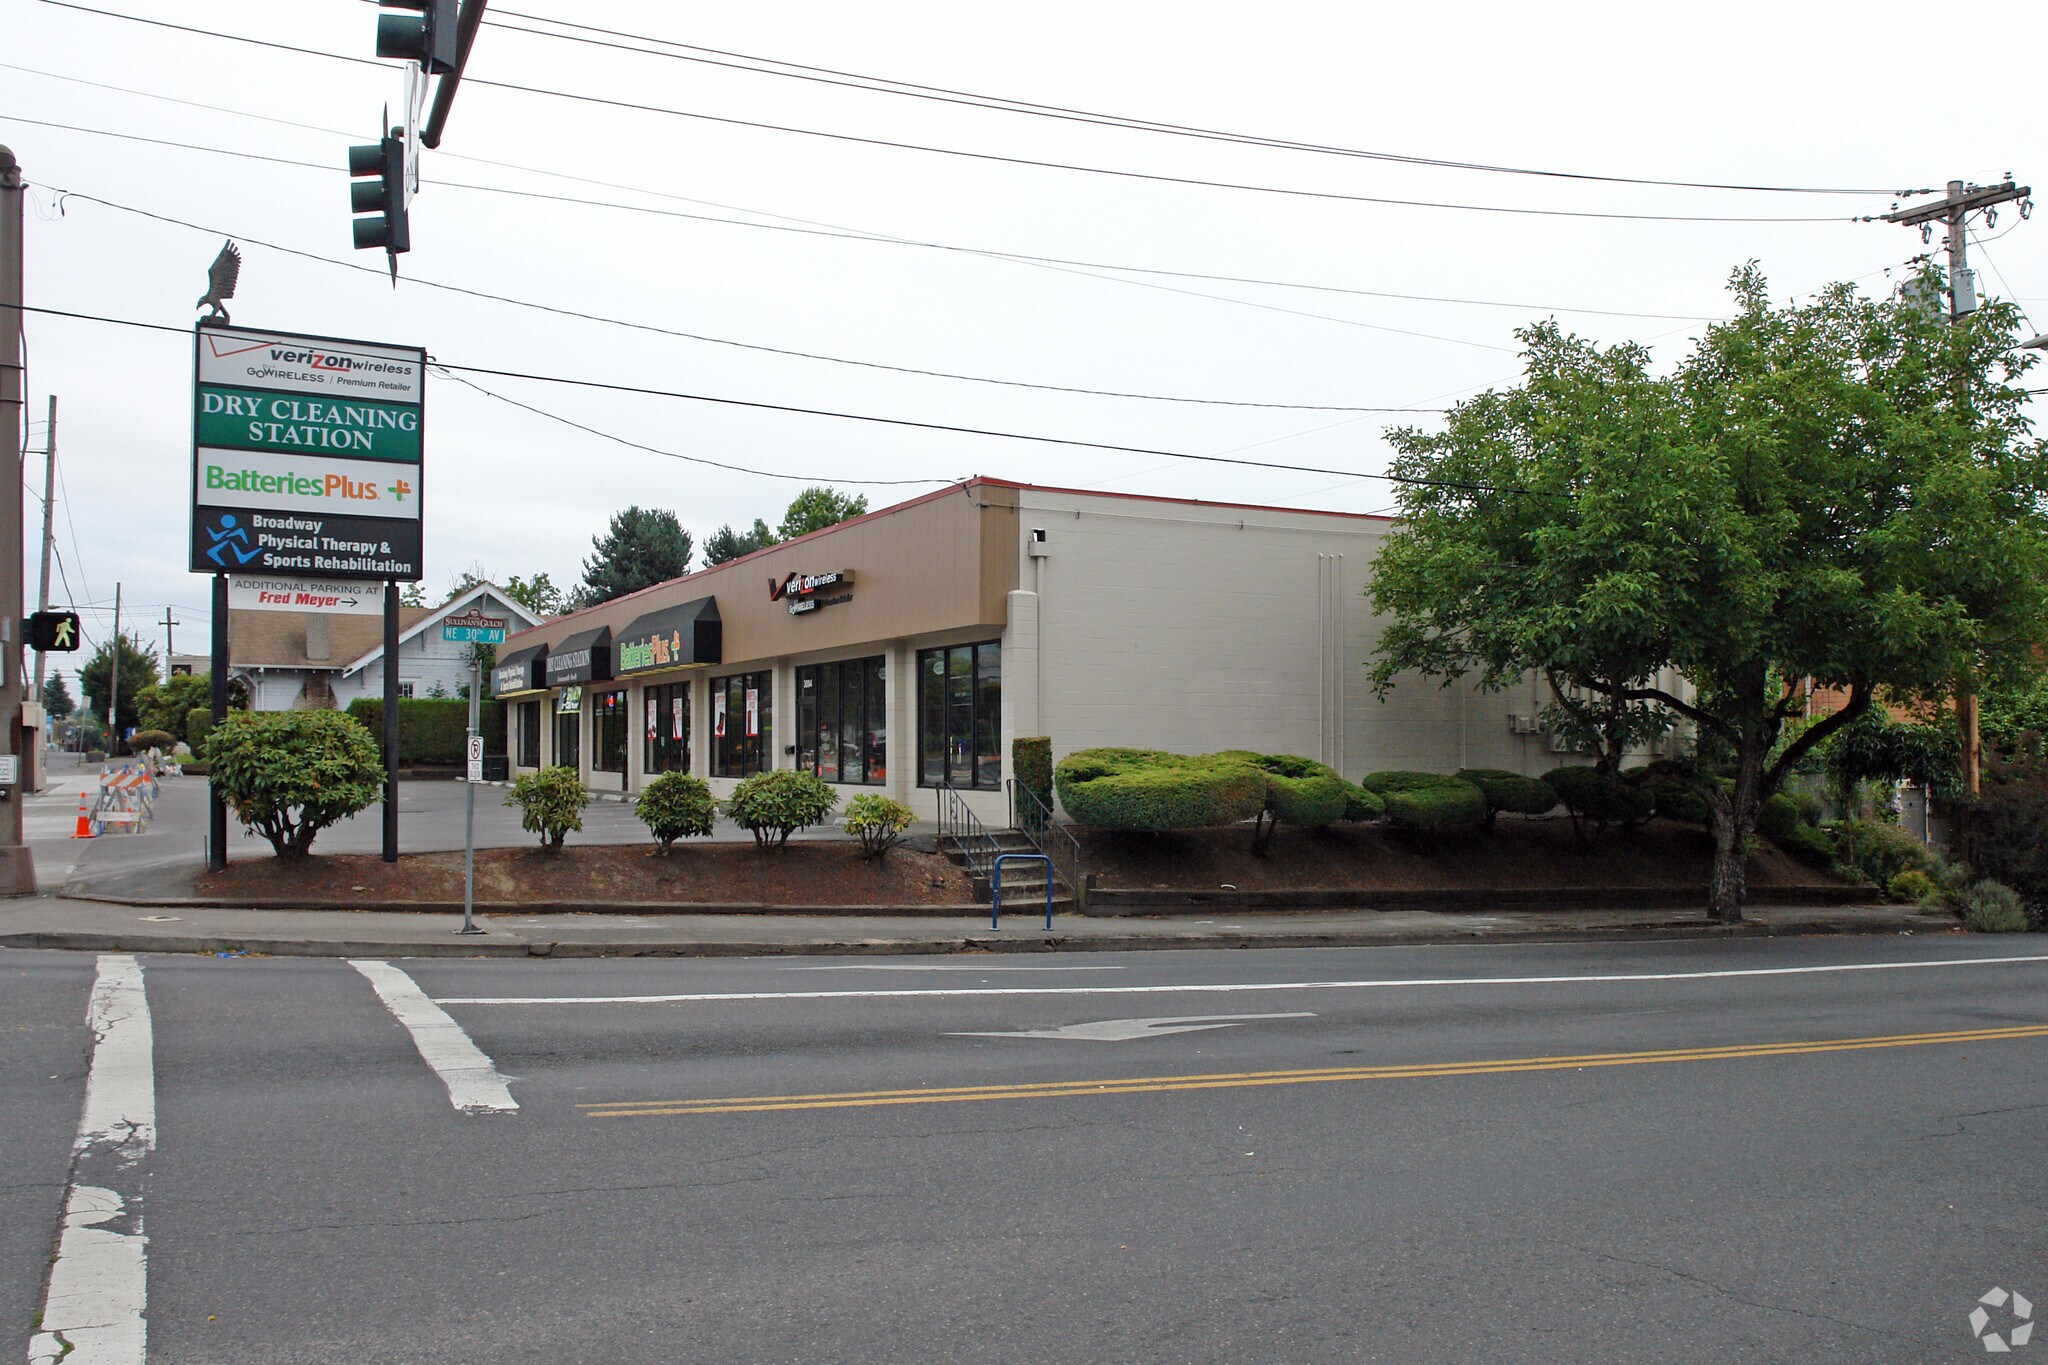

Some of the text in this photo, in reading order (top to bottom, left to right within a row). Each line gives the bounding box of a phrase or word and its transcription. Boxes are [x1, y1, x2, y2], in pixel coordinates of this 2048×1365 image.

[336, 376, 377, 388] Premium
[378, 381, 411, 391] Retailer
[202, 392, 418, 431] DRY CLEANING
[248, 422, 373, 451] STATION
[252, 514, 322, 533] Broadway
[258, 533, 391, 555] Physical Therapy &
[263, 553, 412, 573] Sports Rehabilitation
[234, 580, 379, 595] ADDITIONAL PARKING AT
[258, 591, 340, 607] Fred Meyer
[480, 619, 503, 628] GULCH
[445, 628, 457, 639] NE
[488, 629, 500, 640] AV
